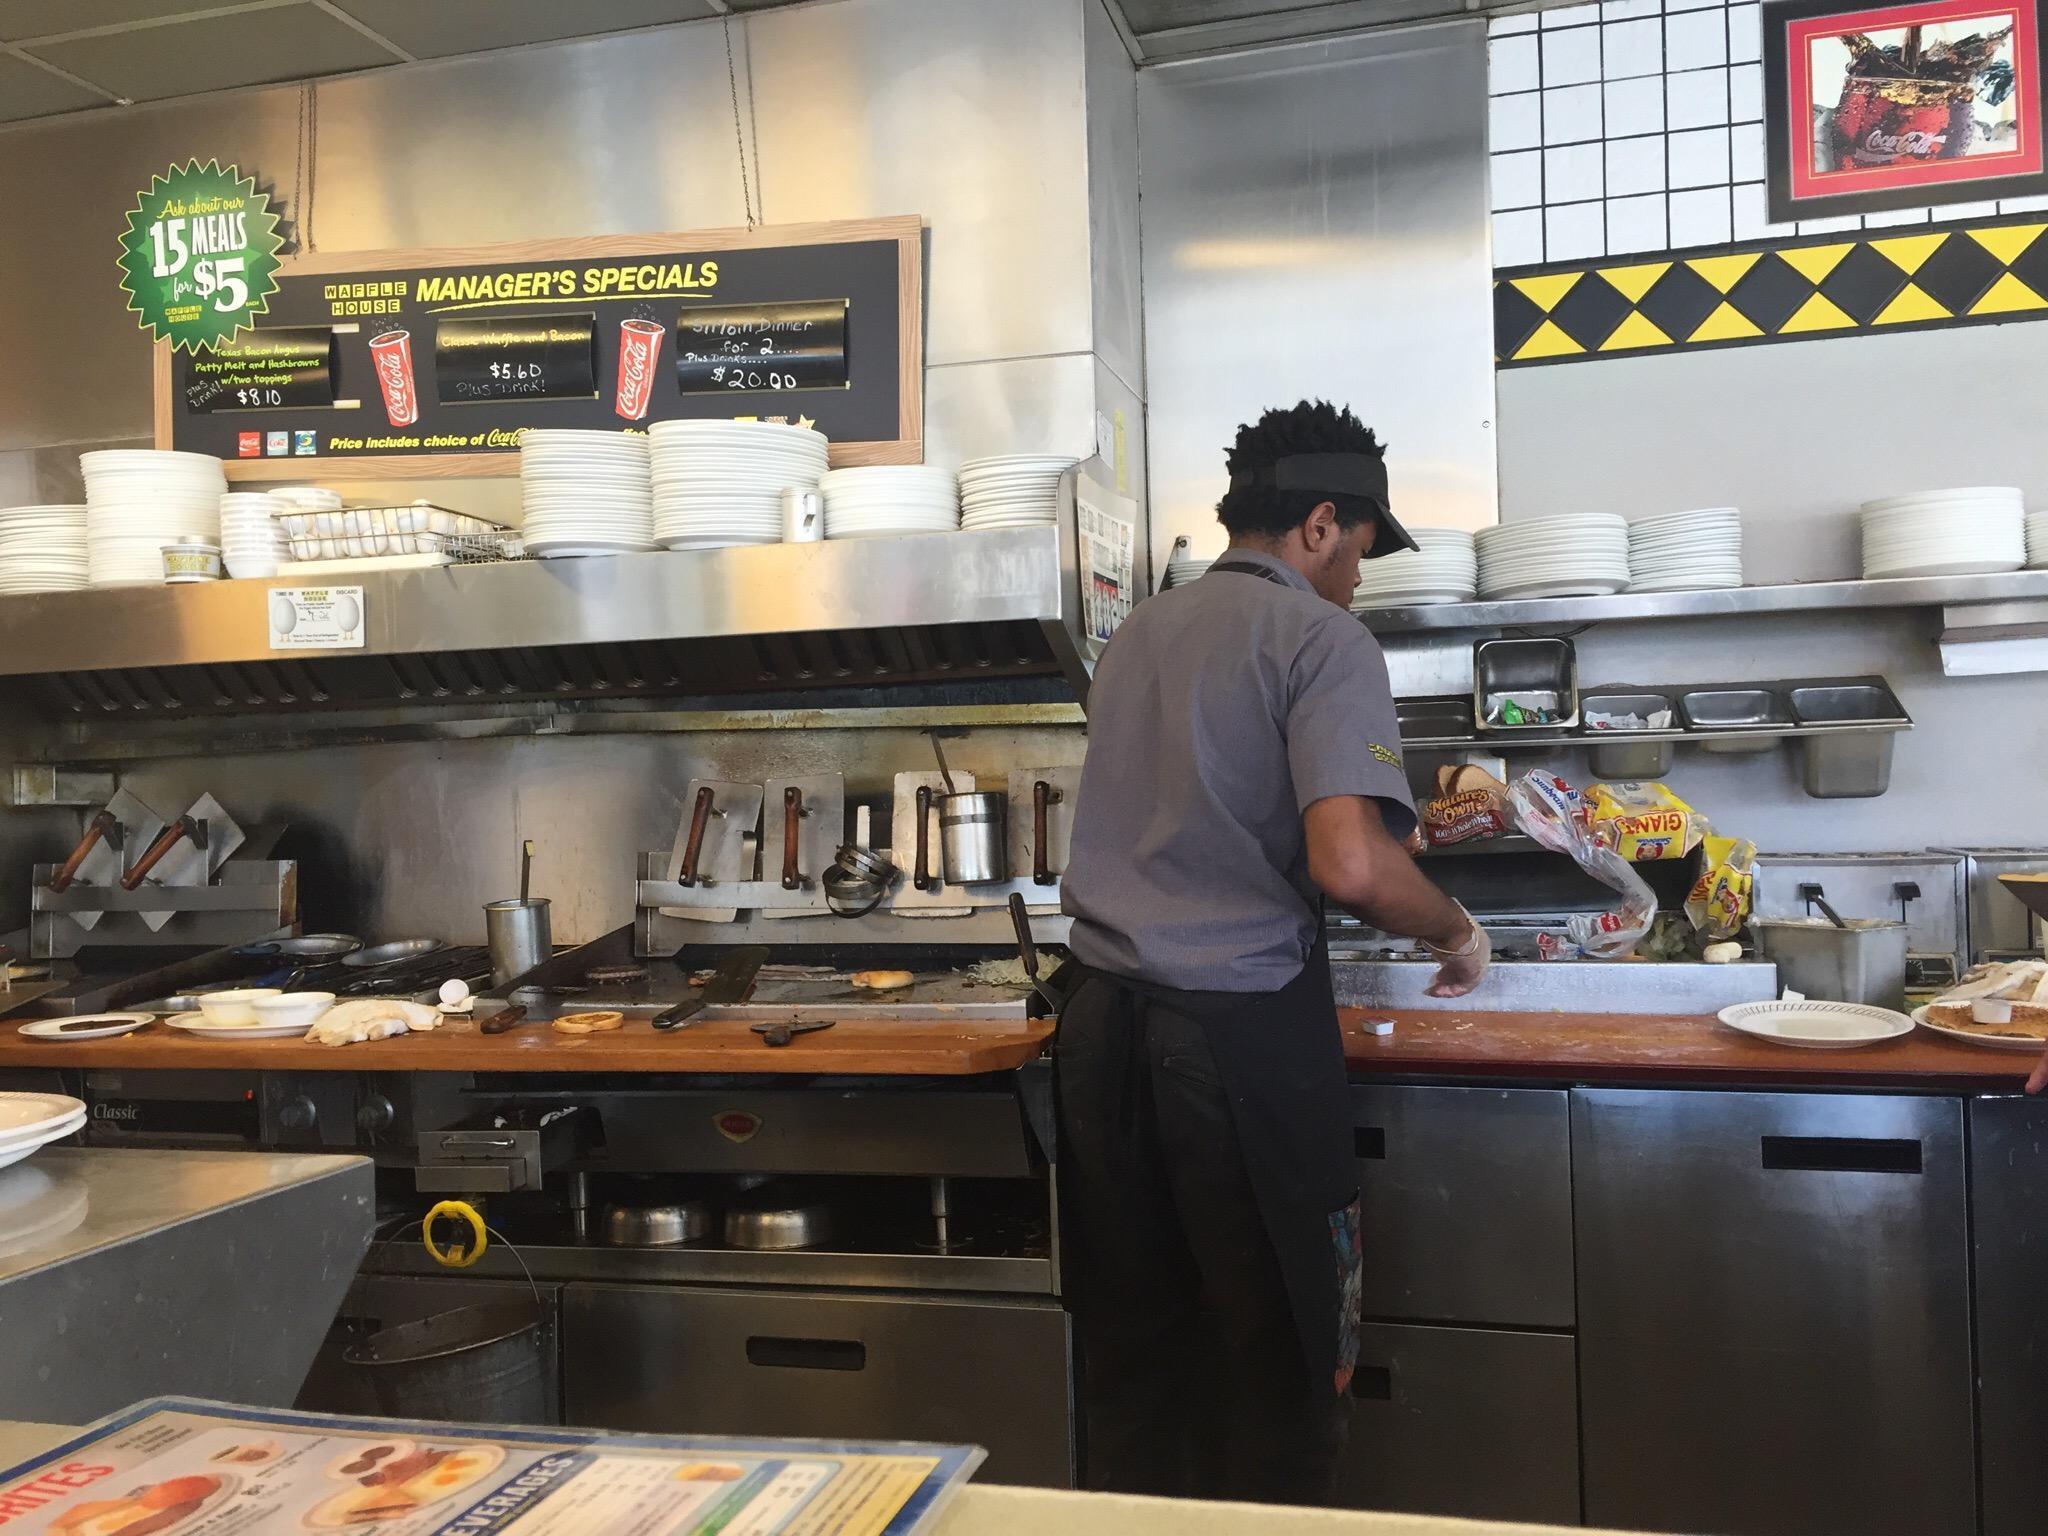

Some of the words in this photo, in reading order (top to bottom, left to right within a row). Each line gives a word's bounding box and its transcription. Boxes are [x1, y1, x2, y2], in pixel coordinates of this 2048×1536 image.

[157, 200, 186, 219] Ask
[189, 197, 219, 214] about
[222, 197, 245, 210] our
[149, 218, 189, 278] 15
[191, 211, 248, 256] MEALS
[173, 277, 192, 302] for
[193, 256, 249, 312] $5
[325, 281, 407, 299] WAFFLE
[416, 269, 576, 302] MANAGER'S
[583, 261, 719, 291] SPECIALS
[332, 299, 400, 316] HOUSE
[754, 318, 813, 335] Dinner
[442, 336, 479, 348] Classic
[524, 330, 547, 343] and
[549, 328, 585, 342] Bacon
[720, 340, 750, 353] for
[215, 348, 241, 357] Texas
[245, 345, 271, 356] Bacon
[274, 344, 300, 357] Angus
[684, 352, 708, 363] Plus
[195, 362, 222, 374] Patty
[224, 361, 246, 370] Melt
[248, 361, 265, 370] and
[268, 357, 320, 368] Hashbrowns
[489, 361, 543, 380] $5.60
[220, 374, 251, 385] w/two
[254, 373, 293, 385] toppings
[330, 437, 362, 449] Price
[366, 434, 420, 448] includes
[424, 433, 472, 447] choice
[471, 432, 486, 446] of
[1428, 789, 1490, 818] Nature's
[1443, 801, 1477, 825] Own
[93, 1103, 139, 1120] Classic
